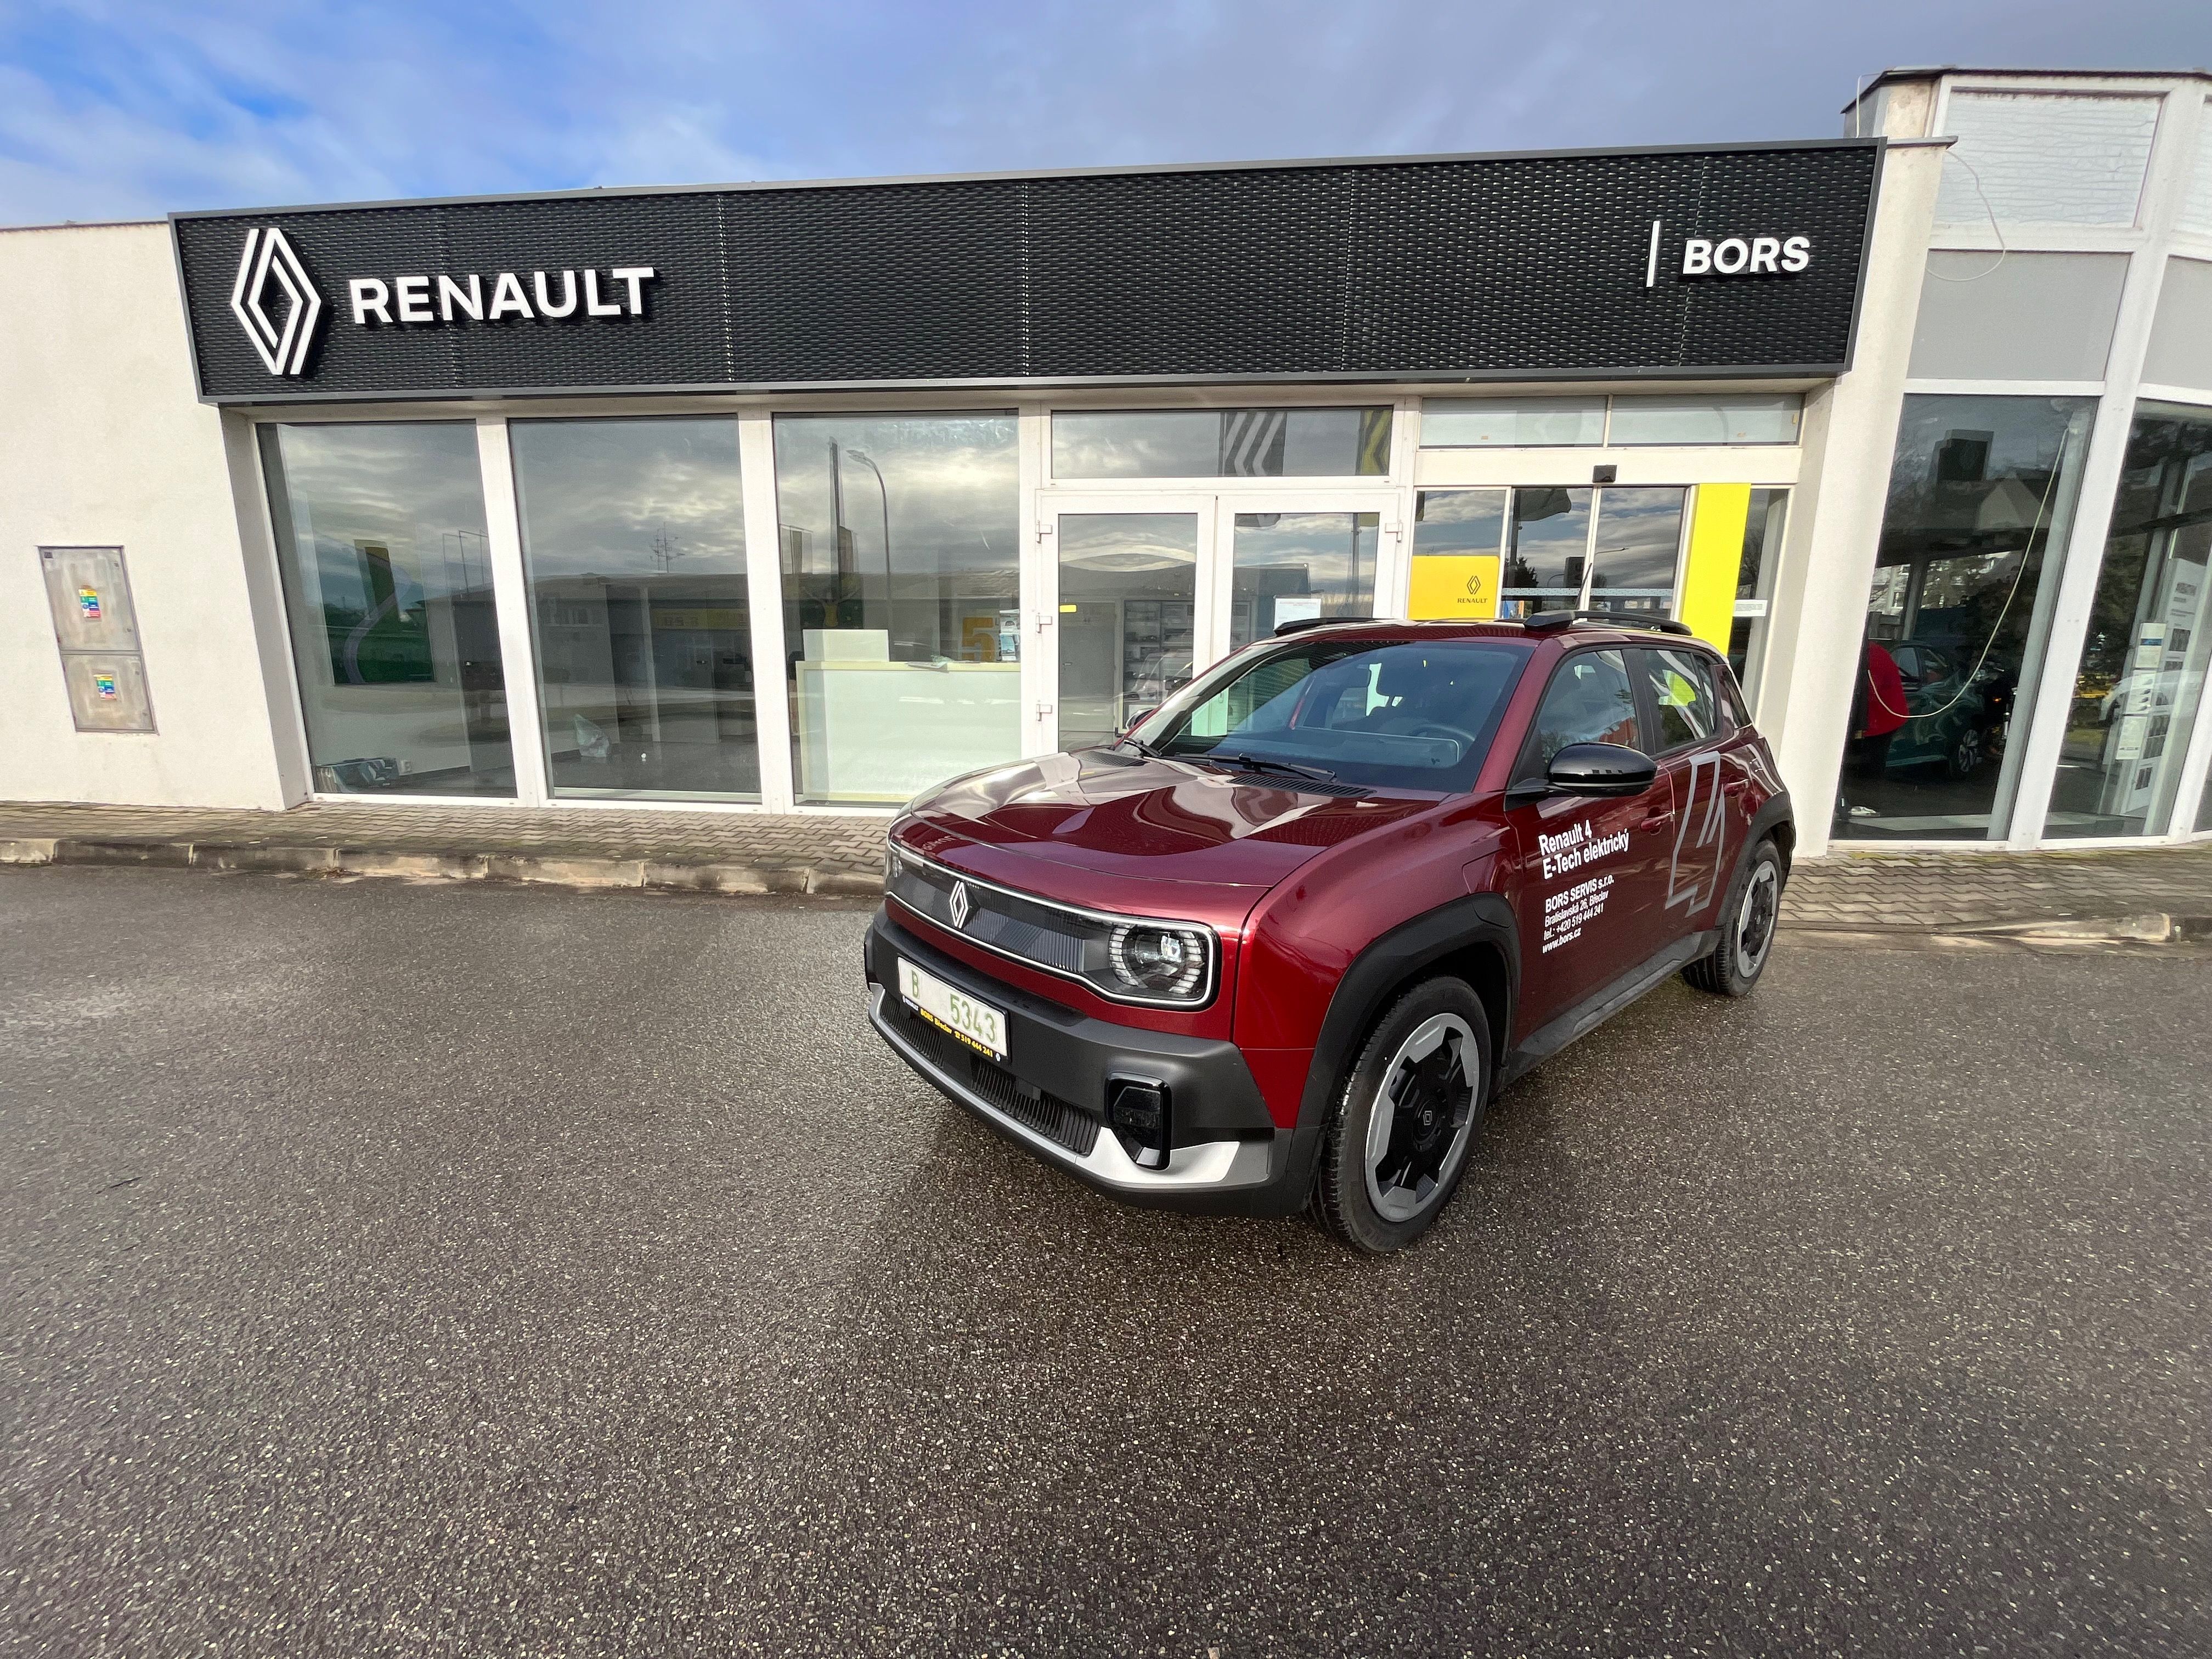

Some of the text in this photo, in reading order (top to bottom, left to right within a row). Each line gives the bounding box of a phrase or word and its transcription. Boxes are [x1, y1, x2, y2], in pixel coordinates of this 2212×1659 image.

[1683, 236, 1810, 274] BORS
[348, 267, 654, 325] RENAULT
[1538, 819, 1592, 856] Renault 4
[1543, 828, 1629, 879] E-Tech elektrický
[1545, 874, 1615, 913] BORS SERVIS s.r.o.
[1544, 902, 1579, 927] Bratislavská
[1556, 918, 1571, 933] +420
[1571, 912, 1582, 927] 519
[1593, 902, 1604, 916] 241
[1542, 927, 1582, 953] www.bors.cz
[950, 994, 996, 1043] 5343
[961, 1033, 971, 1045] 519
[972, 1040, 982, 1051] 444
[982, 1046, 993, 1058] 241
